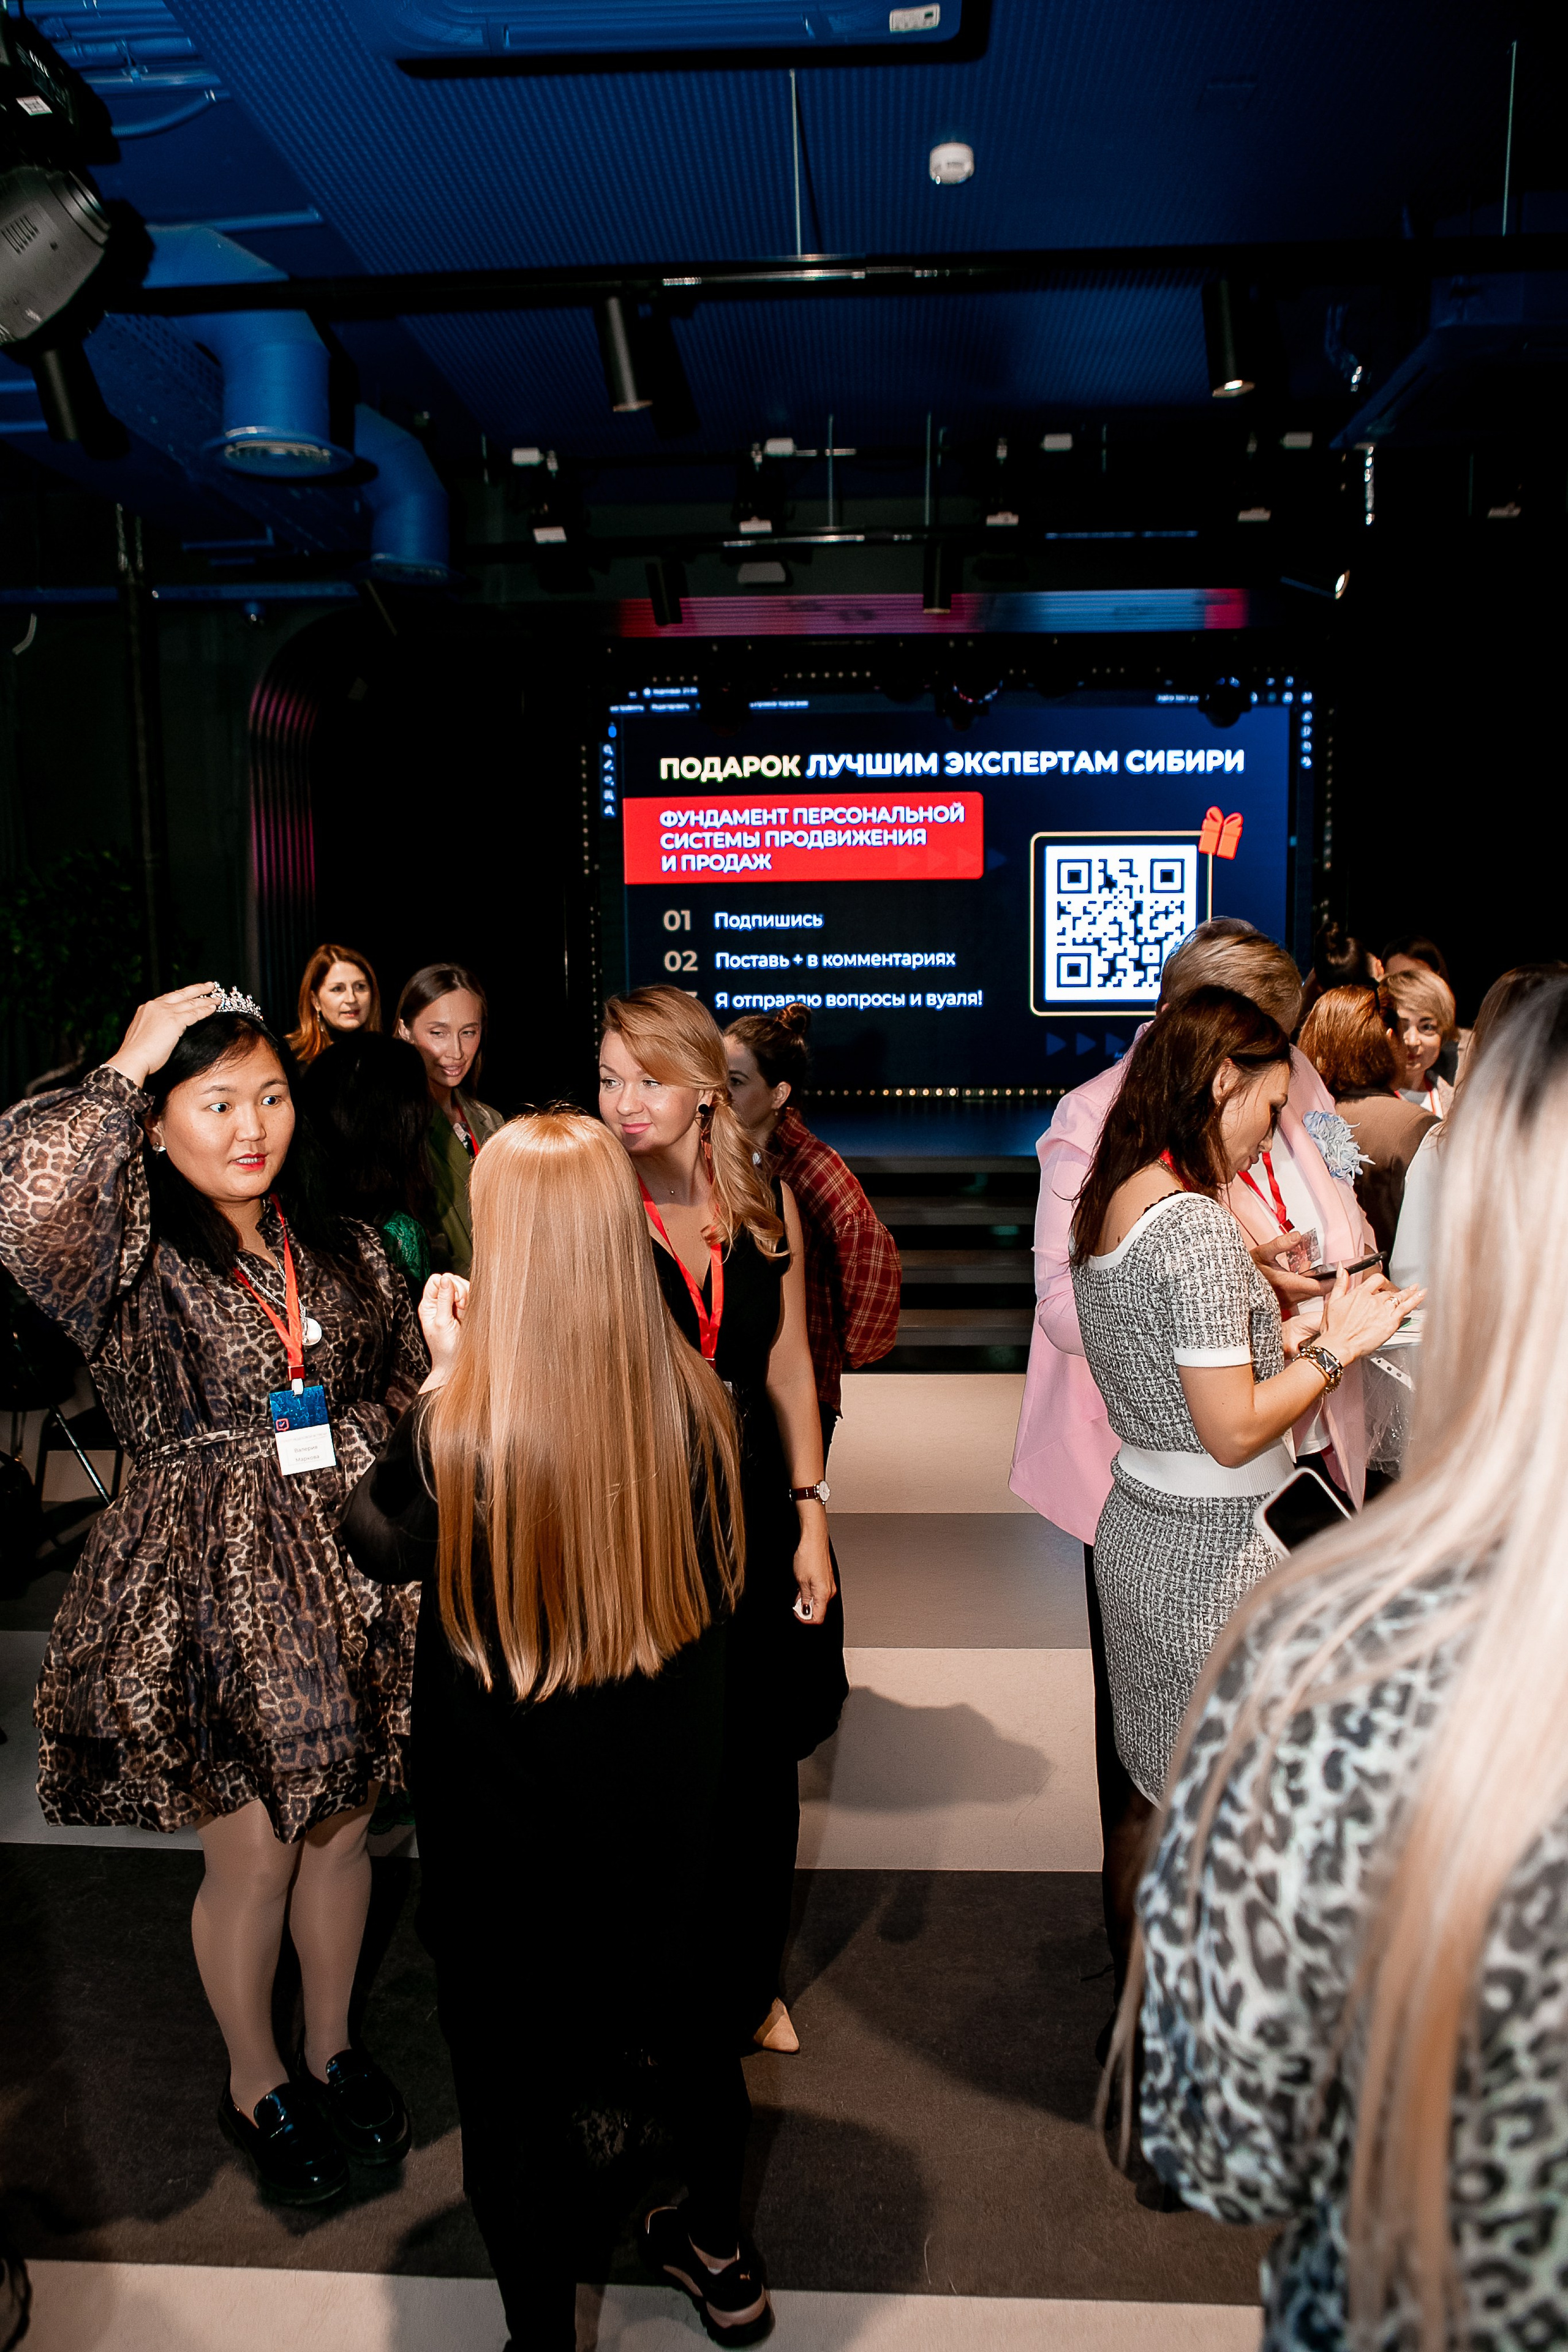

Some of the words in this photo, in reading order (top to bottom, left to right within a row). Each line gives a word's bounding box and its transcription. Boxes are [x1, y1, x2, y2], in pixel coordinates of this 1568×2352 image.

[660, 755, 801, 783] ПОДАРОК
[805, 752, 938, 777] ЛУЧШИМ
[944, 750, 1119, 776] ЭКСПЕРТАМ
[1125, 749, 1245, 773] СИБИРИ
[659, 807, 790, 829] ФУНДАМЕНТ
[793, 802, 965, 826] ПЕРСОНАЛЬНОЙ
[660, 831, 760, 850] СИСТЕМЫ
[764, 828, 927, 850] ПРОДВИЖЕНИЯ
[662, 855, 677, 872] И
[680, 853, 772, 874] ПРОДАЖ
[663, 910, 691, 932] 01
[714, 912, 824, 931] Подпишись
[663, 950, 699, 972] 02
[715, 952, 790, 969] Поставь
[807, 954, 819, 968] в
[822, 952, 956, 970] комментариях
[715, 992, 729, 1009] Я
[826, 993, 906, 1011] вопросы
[909, 993, 922, 1006] и
[926, 990, 983, 1011] вуаля!
[294, 1445, 318, 1453] Валерия
